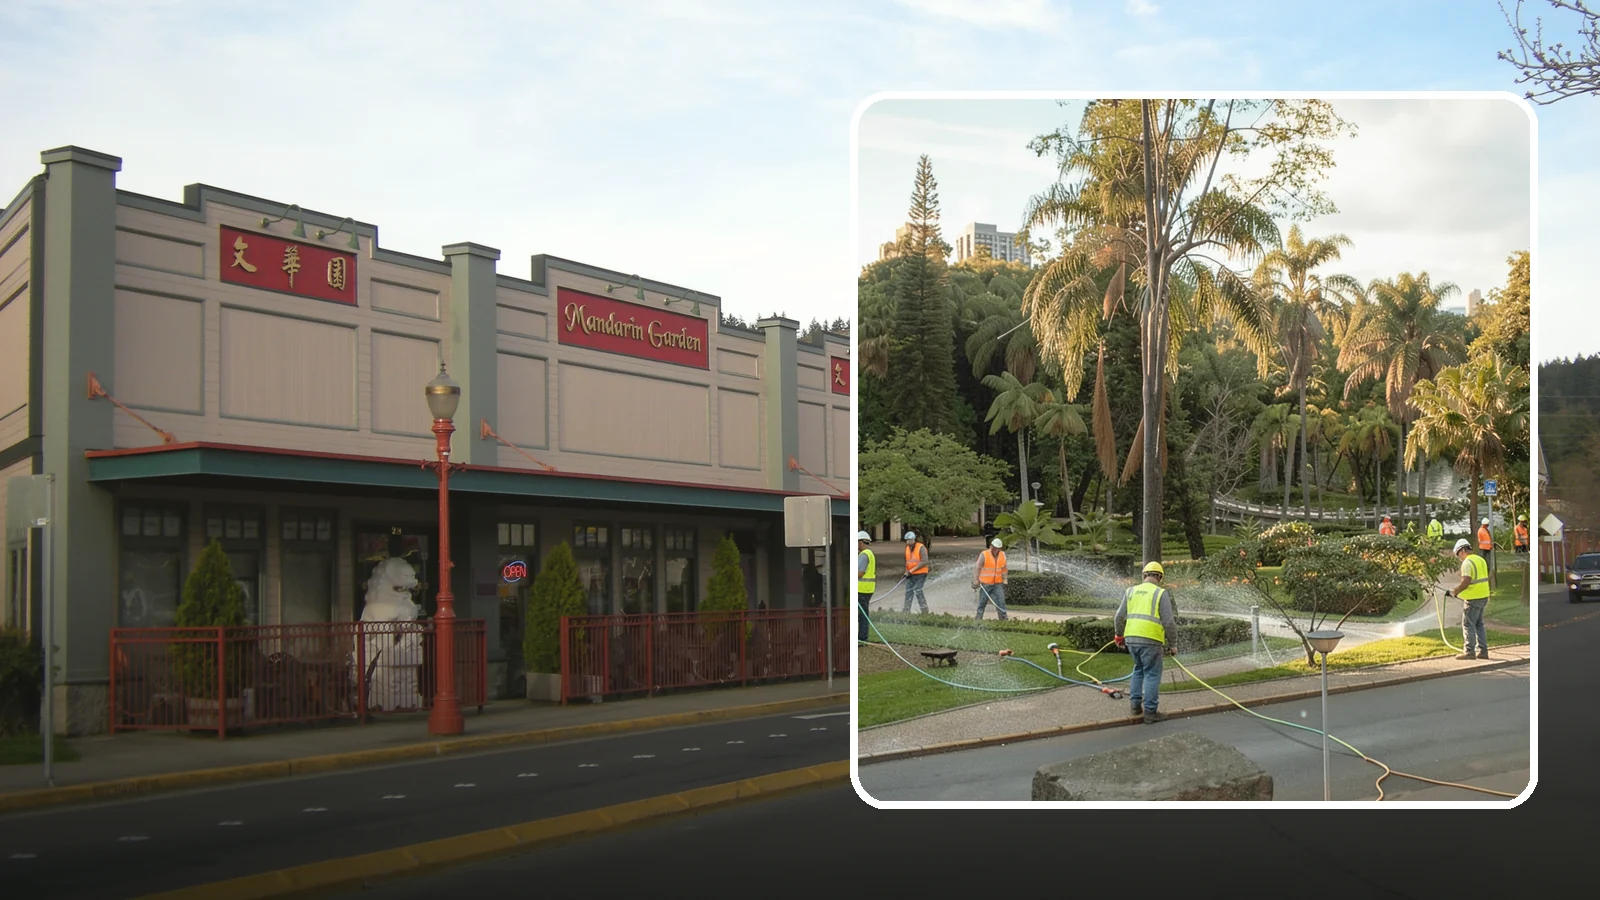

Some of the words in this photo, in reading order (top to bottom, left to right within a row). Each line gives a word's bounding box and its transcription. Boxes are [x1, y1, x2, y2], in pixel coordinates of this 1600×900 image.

[231, 236, 346, 291] 文華園
[564, 302, 644, 341] Mandarin
[648, 320, 702, 352] Garden
[503, 565, 528, 579] OPEN
